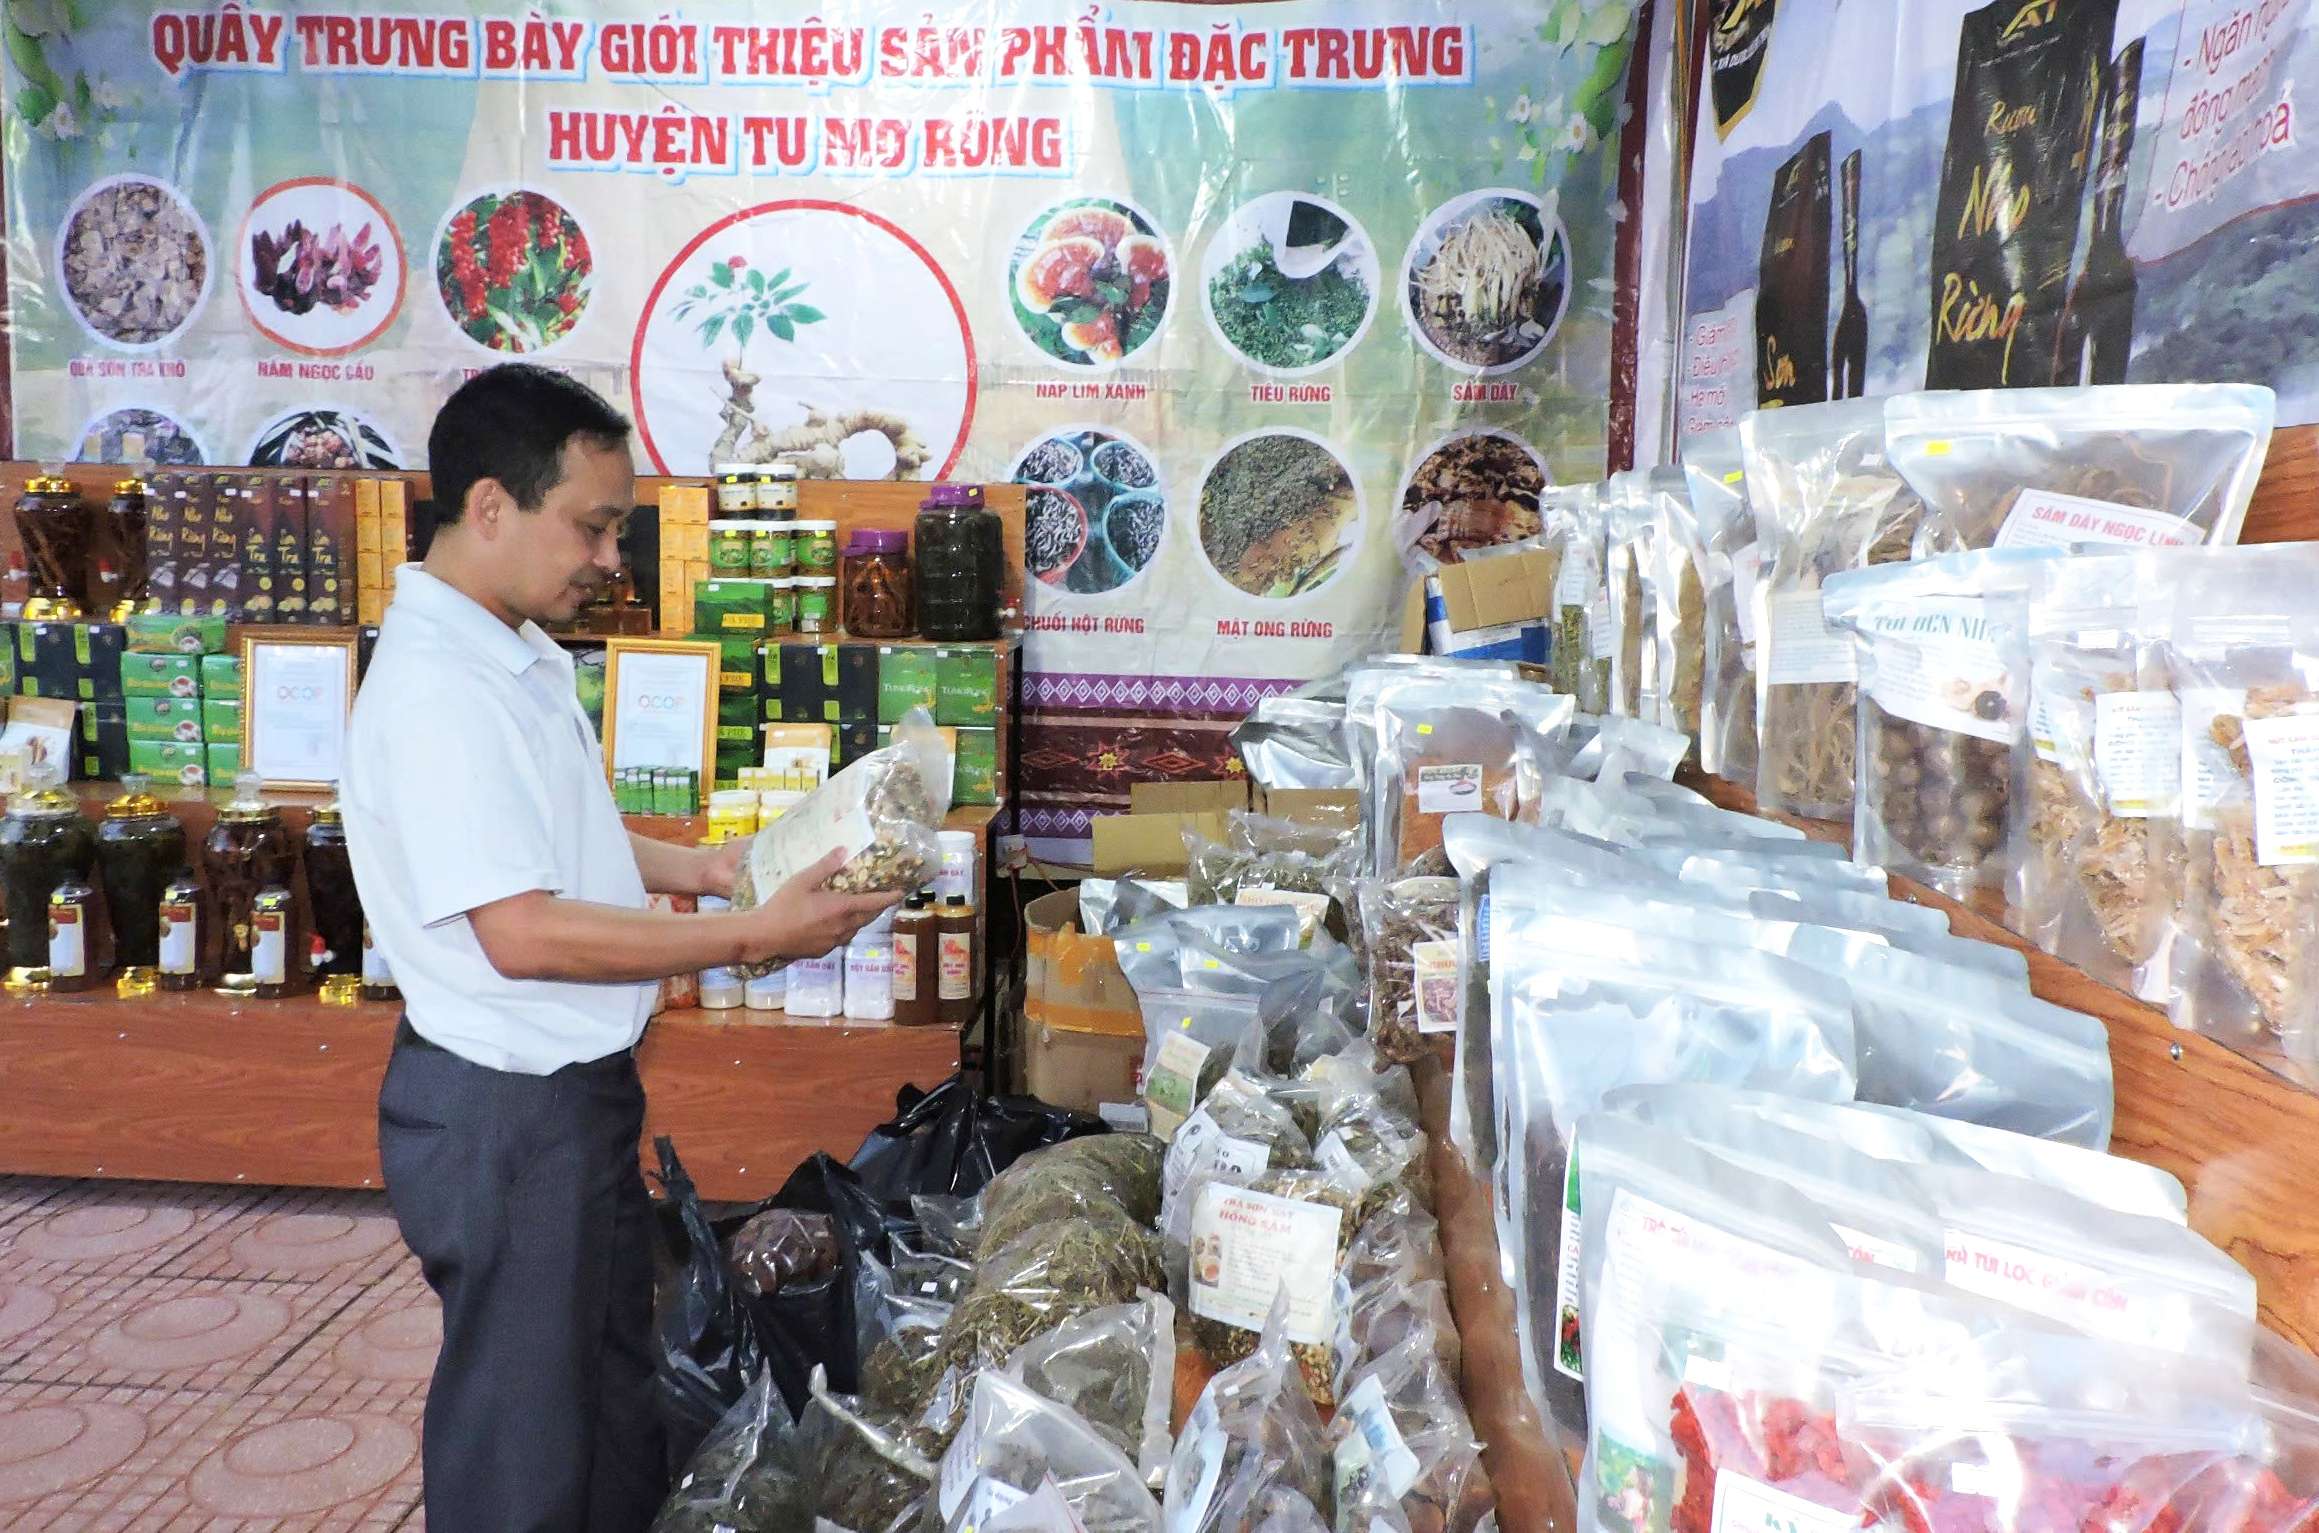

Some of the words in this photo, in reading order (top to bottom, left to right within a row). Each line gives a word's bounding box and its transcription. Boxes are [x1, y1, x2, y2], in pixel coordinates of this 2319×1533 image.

[296, 15, 470, 69] TRƯNG
[485, 10, 584, 71] BÀY
[600, 13, 698, 74] GIỚI
[713, 15, 864, 86] THIỆU
[1001, 3, 1153, 80] PHẨM
[1169, 23, 1267, 91] ĐẶC
[1283, 24, 1463, 79] TRƯNG
[549, 104, 728, 176] HUYỆN
[743, 117, 808, 166] TU
[1254, 620, 1286, 638] ONG
